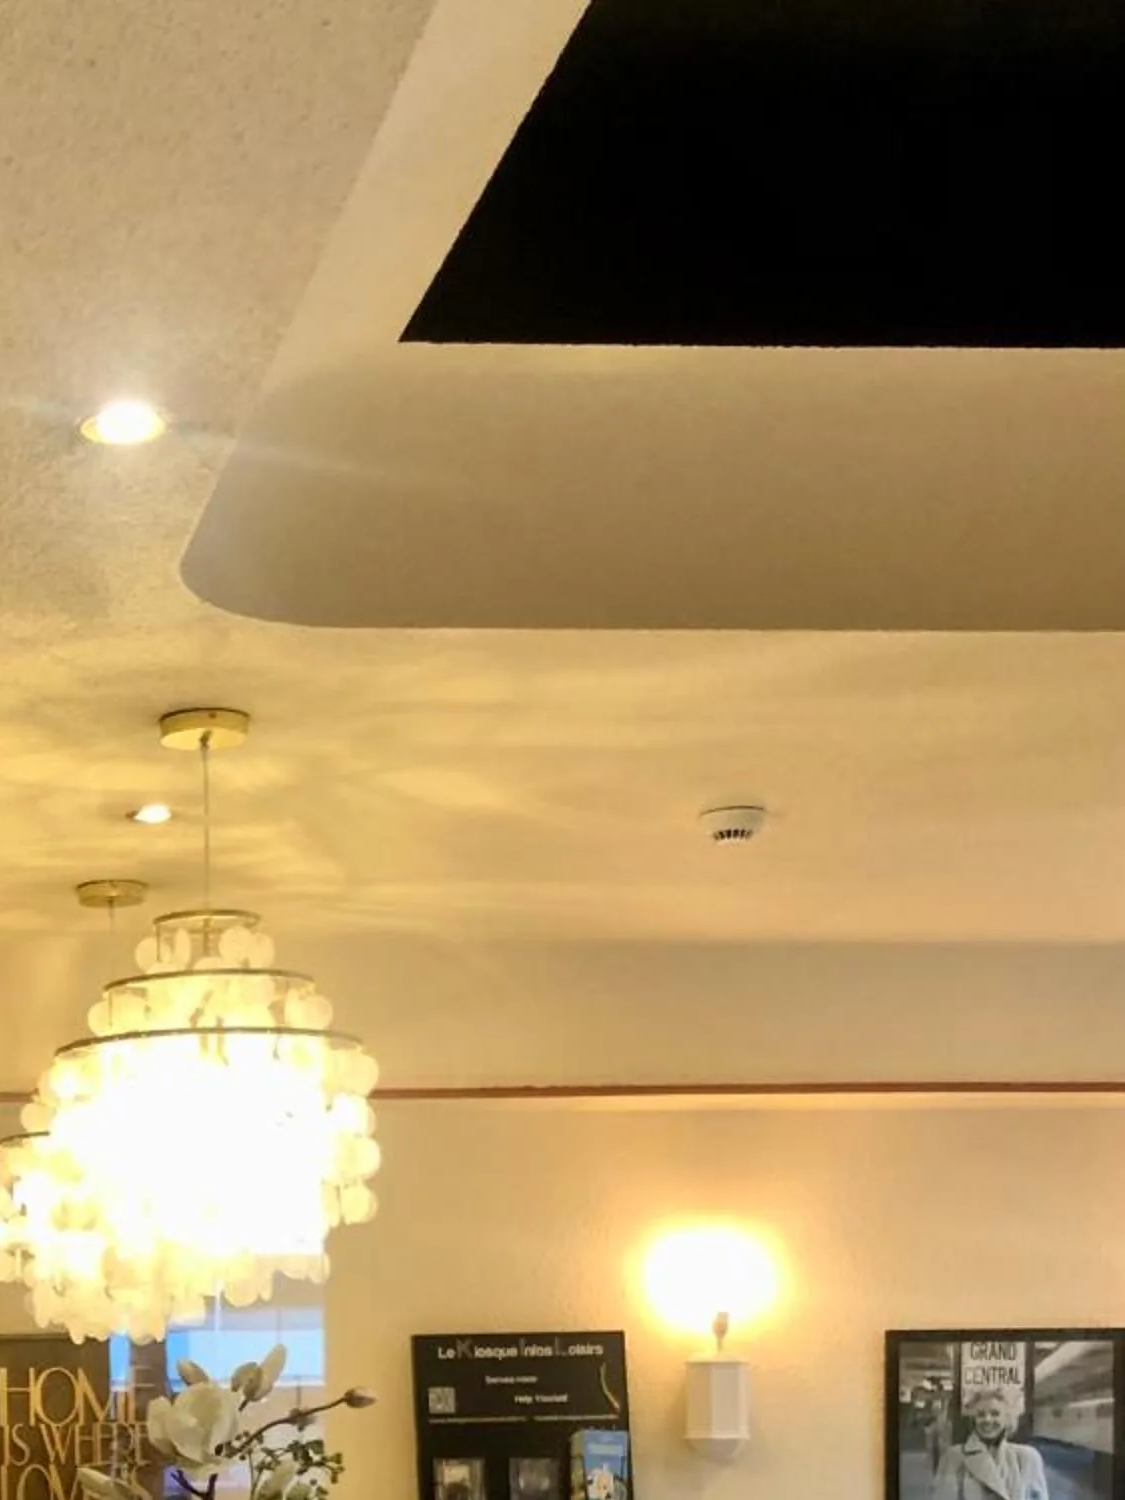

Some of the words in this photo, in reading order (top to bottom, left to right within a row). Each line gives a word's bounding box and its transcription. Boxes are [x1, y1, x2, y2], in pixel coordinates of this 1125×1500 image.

[437, 1346, 455, 1360] Le
[456, 1338, 518, 1361] Kiosque
[519, 1337, 553, 1358] Infos
[554, 1336, 604, 1357] Loisirs
[970, 1342, 1017, 1361] GRAND
[964, 1366, 1022, 1386] CENTRAL
[3, 1422, 31, 1467] IS
[40, 1421, 153, 1468] WHERE
